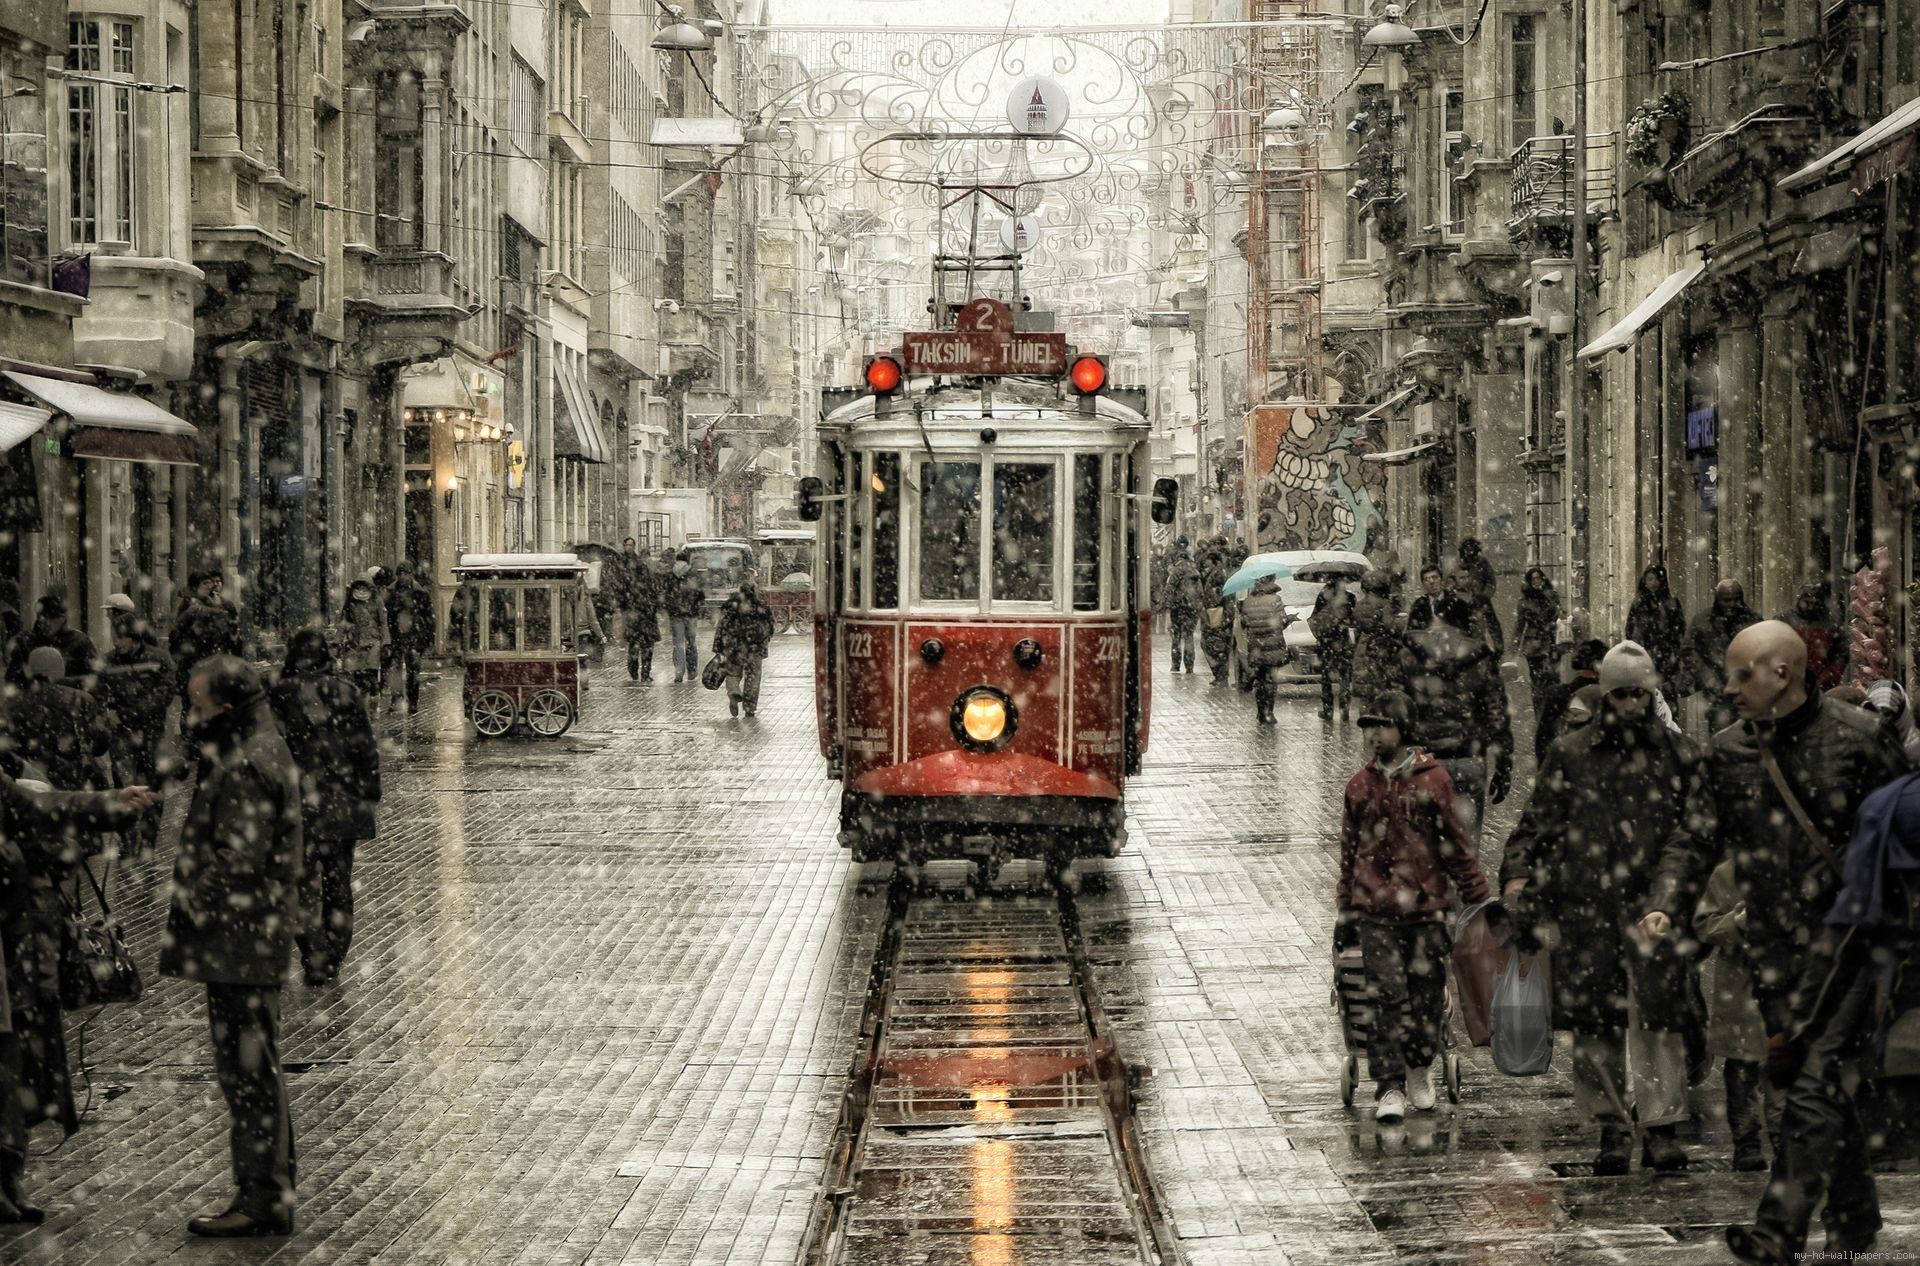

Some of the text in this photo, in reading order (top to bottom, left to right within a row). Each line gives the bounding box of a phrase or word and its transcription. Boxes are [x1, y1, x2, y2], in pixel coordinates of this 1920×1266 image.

[976, 303, 994, 330] 2
[909, 338, 971, 364] TAKSİM
[1000, 339, 1057, 364] TÜNEL
[849, 632, 872, 658] 223
